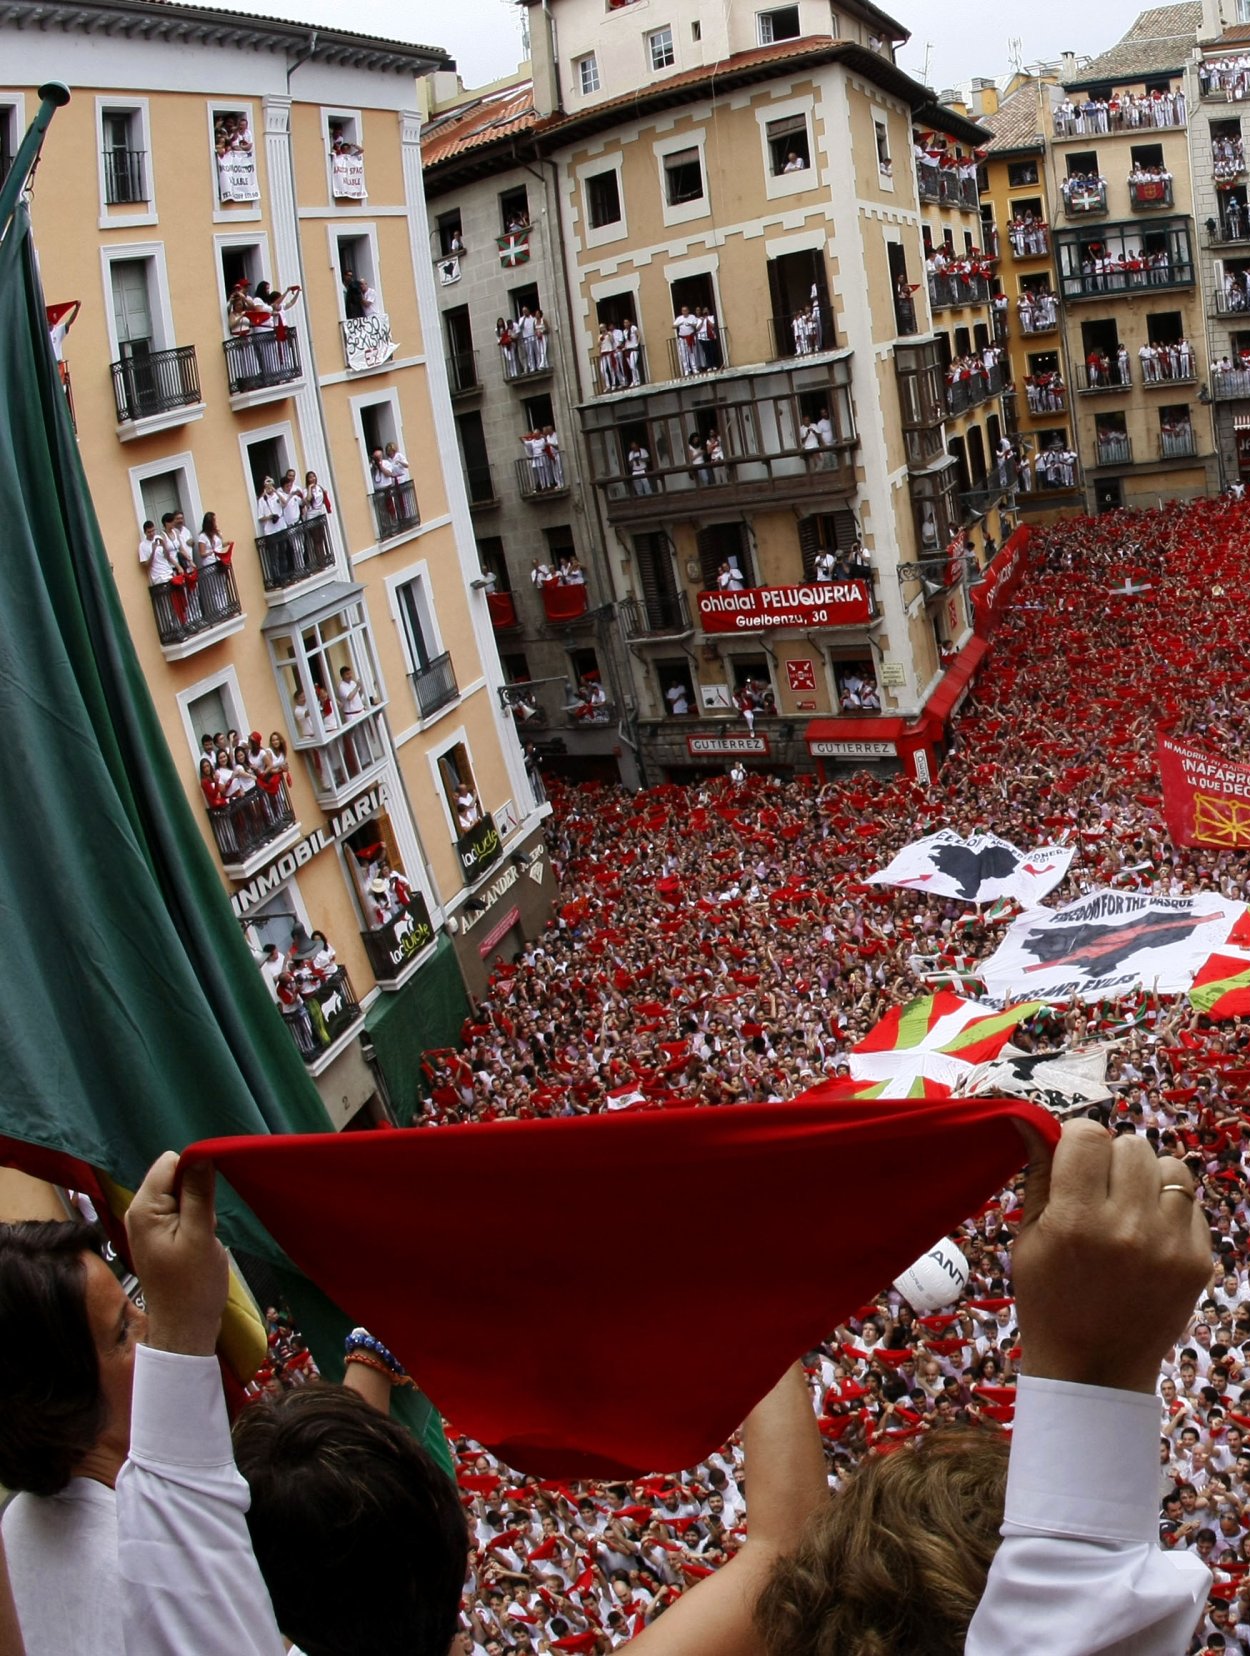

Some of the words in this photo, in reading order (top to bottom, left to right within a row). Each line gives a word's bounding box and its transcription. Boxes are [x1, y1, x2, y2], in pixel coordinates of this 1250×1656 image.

[1105, 494, 1112, 502] 6
[701, 592, 756, 613] ohlala!
[761, 584, 863, 609] PELUQUERIA
[736, 613, 808, 627] Guelbenzu,
[812, 609, 828, 622] 30
[694, 738, 762, 750] GUTIERREZ
[817, 743, 890, 754] GUTIERREZ
[1164, 740, 1173, 750] NI
[1187, 775, 1198, 786] LA
[1199, 778, 1221, 791] QUE
[230, 782, 393, 918] INMOBILIARIA
[519, 844, 544, 873] JOERO
[1101, 893, 1124, 917] FOR
[1124, 895, 1147, 913] THE
[342, 1095, 351, 1111] 2
